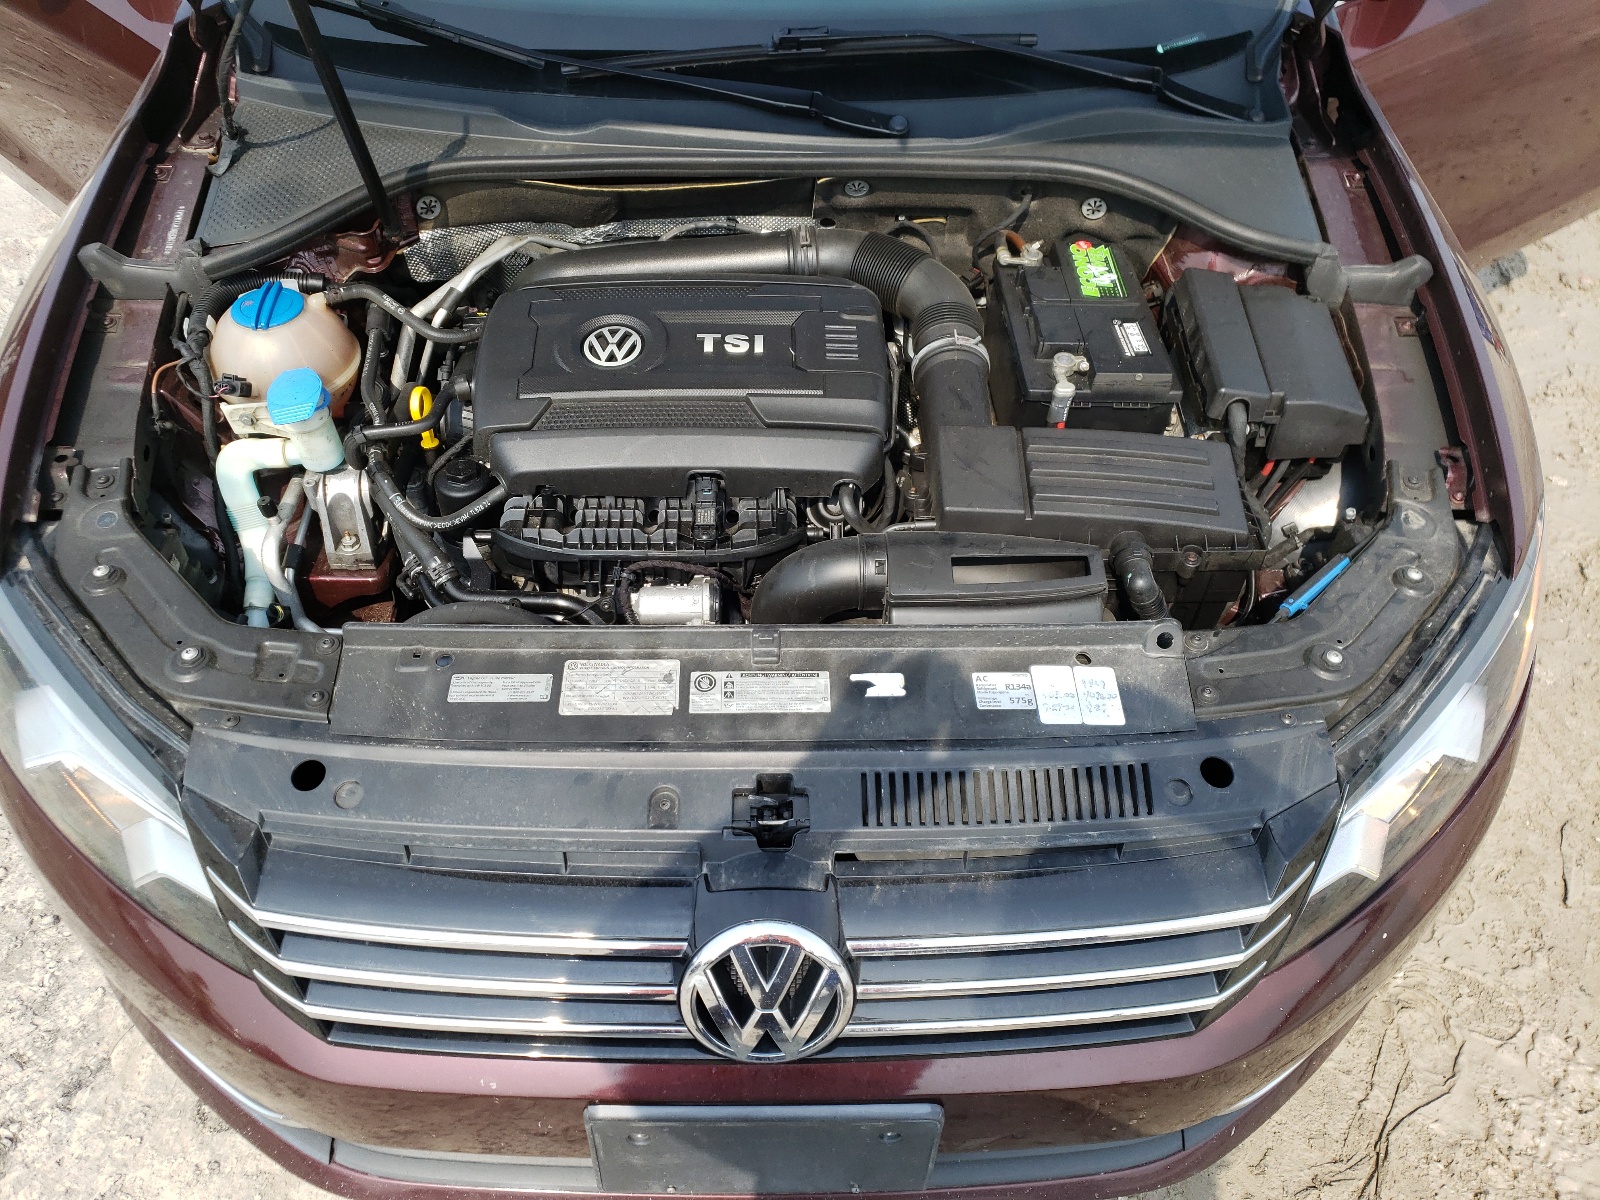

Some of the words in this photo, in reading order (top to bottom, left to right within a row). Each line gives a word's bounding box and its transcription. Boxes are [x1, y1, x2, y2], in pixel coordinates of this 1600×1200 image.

[583, 325, 642, 367] VW
[696, 333, 764, 353] TSI
[1005, 683, 1032, 691] R134a
[1009, 697, 1034, 707] 575g
[677, 918, 857, 1064] VW
